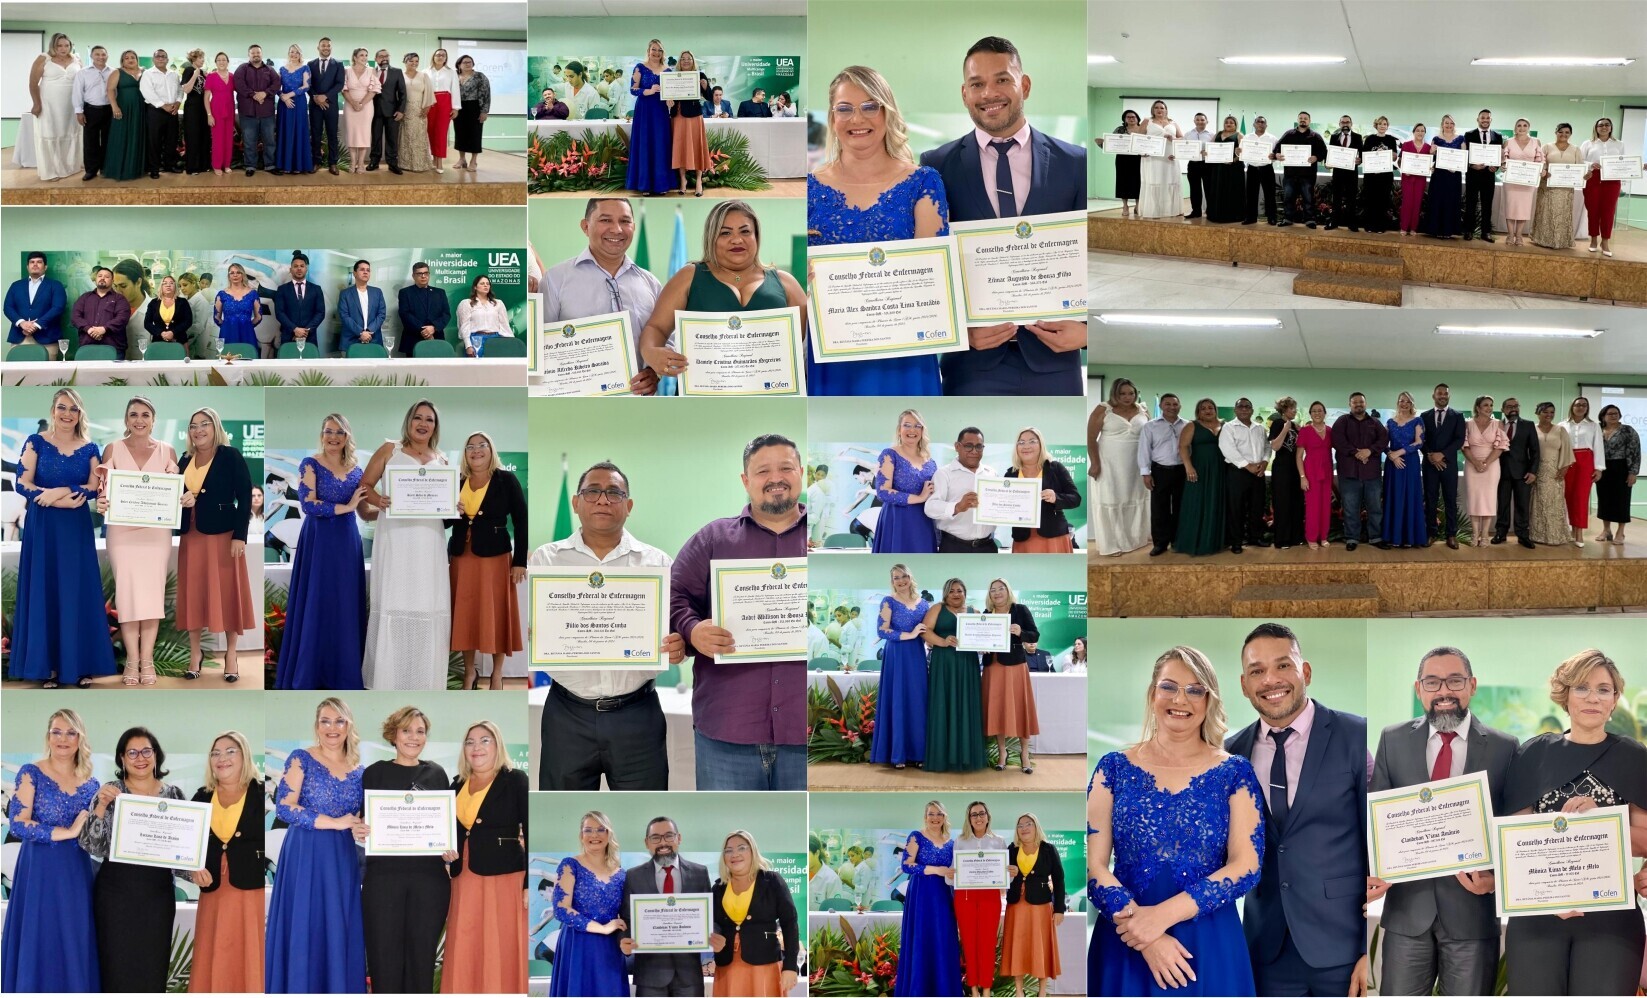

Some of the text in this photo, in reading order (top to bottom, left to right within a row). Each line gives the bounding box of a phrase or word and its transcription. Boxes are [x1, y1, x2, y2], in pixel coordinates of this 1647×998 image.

[476, 63, 503, 71] Coren
[1005, 243, 1029, 252] Federal
[1039, 239, 1078, 248] Enfermagem
[488, 253, 520, 266] UEA
[858, 270, 882, 280] Federal
[892, 268, 933, 276] Enfermagem
[860, 304, 880, 312] Sandra
[925, 330, 946, 338] Cofen
[554, 341, 573, 349] Federal
[608, 382, 624, 390] Cofen
[1624, 414, 1647, 424] Core
[242, 425, 264, 439] UE
[1411, 807, 1430, 816] Federal
